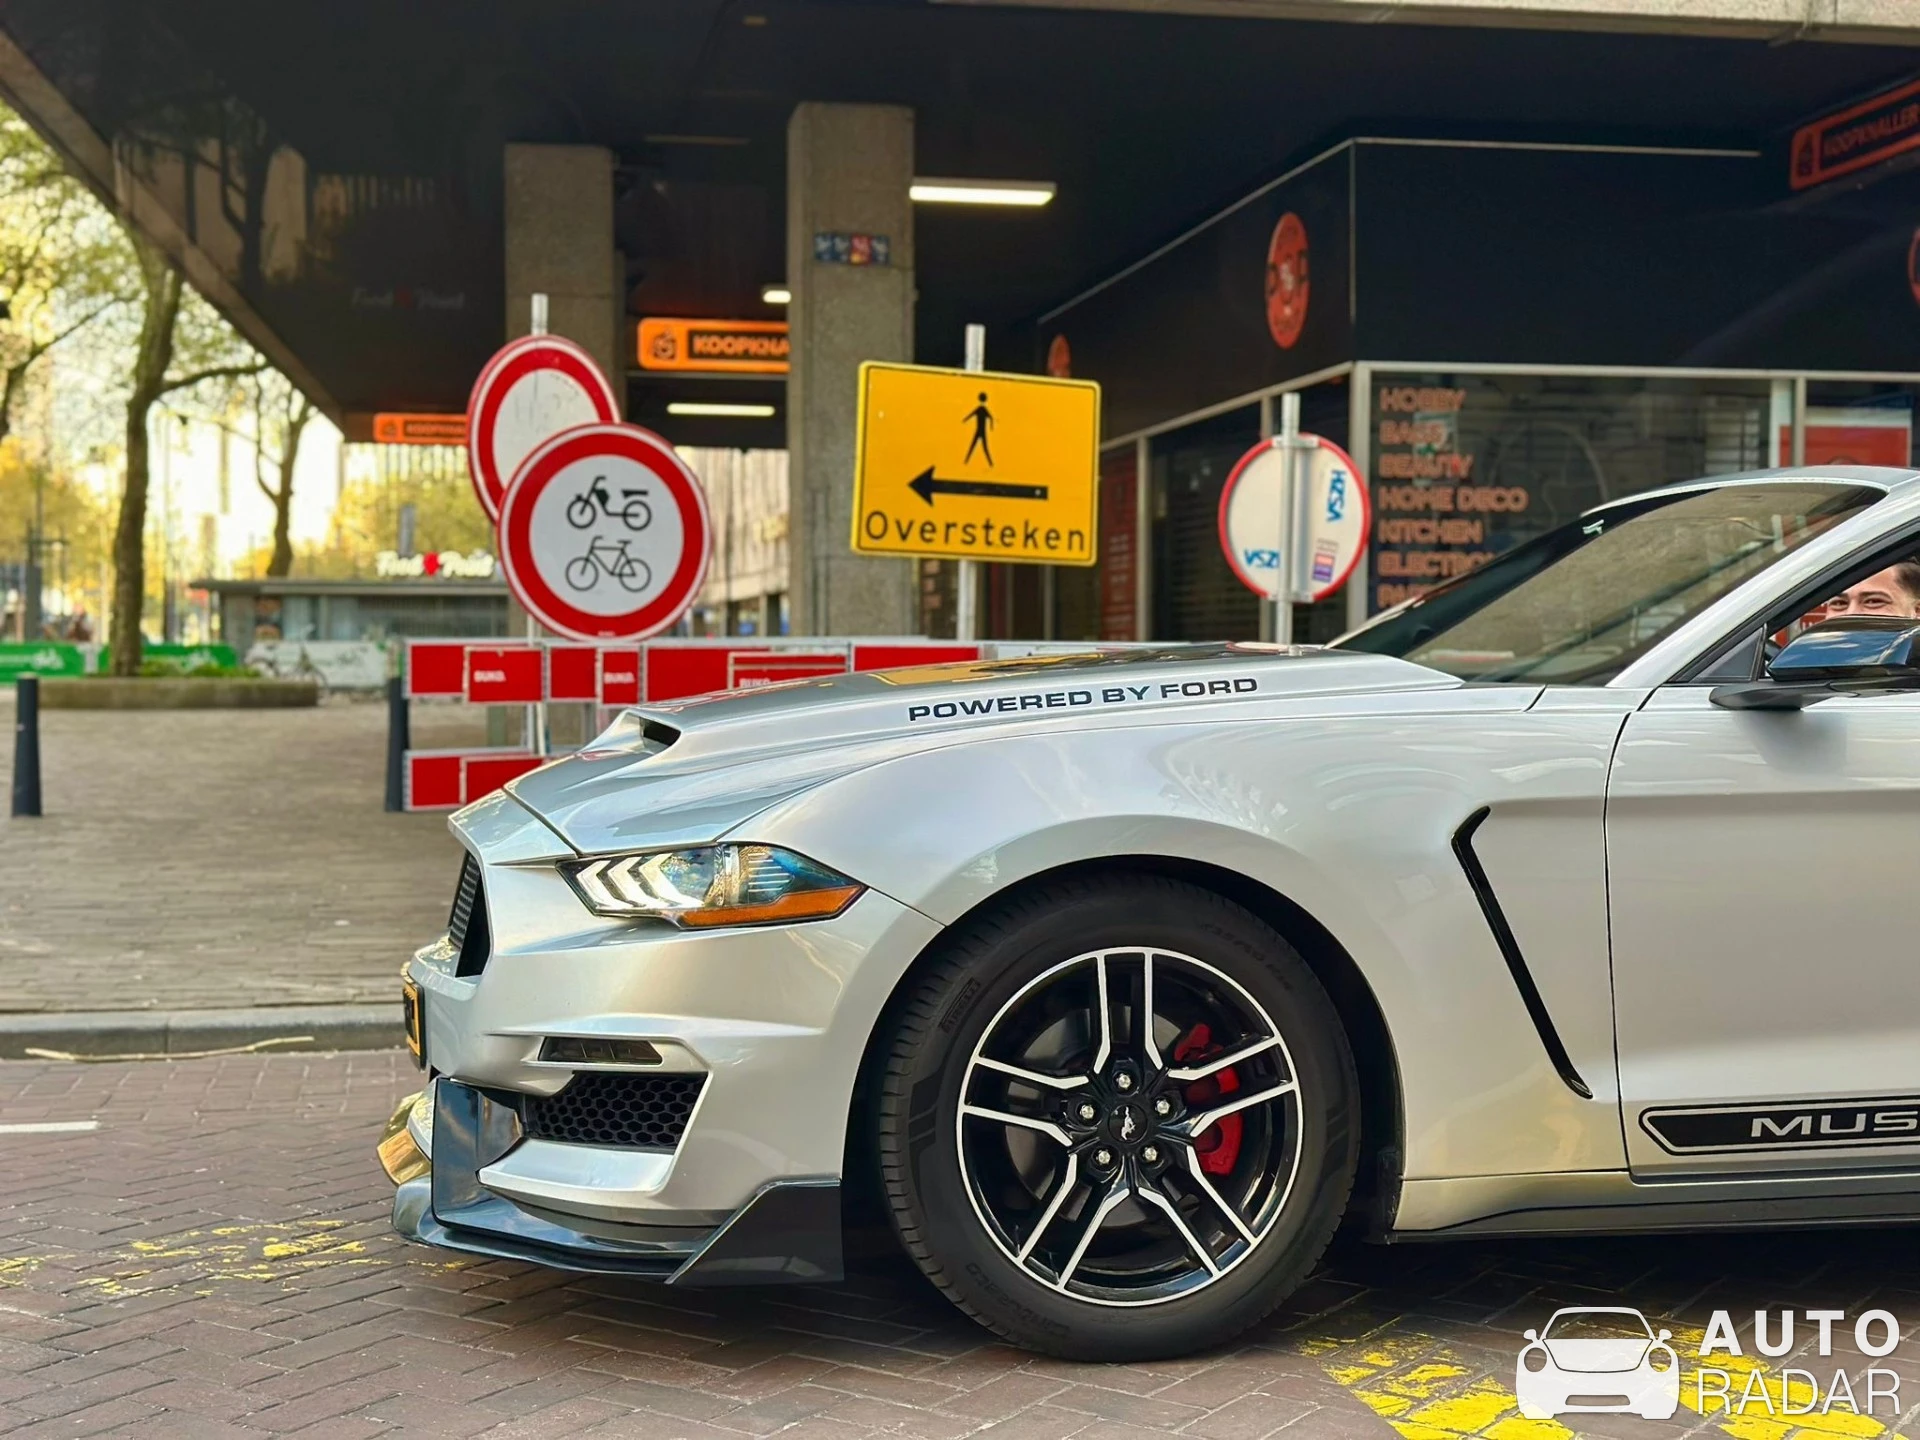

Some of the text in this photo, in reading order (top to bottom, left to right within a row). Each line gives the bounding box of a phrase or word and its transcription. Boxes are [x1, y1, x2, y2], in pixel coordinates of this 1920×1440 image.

[1379, 387, 1467, 412] HOBBY
[1379, 453, 1474, 478] BEAUTY
[1378, 486, 1529, 513] HOME DECO
[865, 510, 1085, 551] Oversteken
[1378, 519, 1483, 545] KITCHEN
[1377, 552, 1495, 577] ELECTRO
[908, 678, 1258, 721] POWERED BY FORD
[1751, 1111, 1919, 1137] MUS
